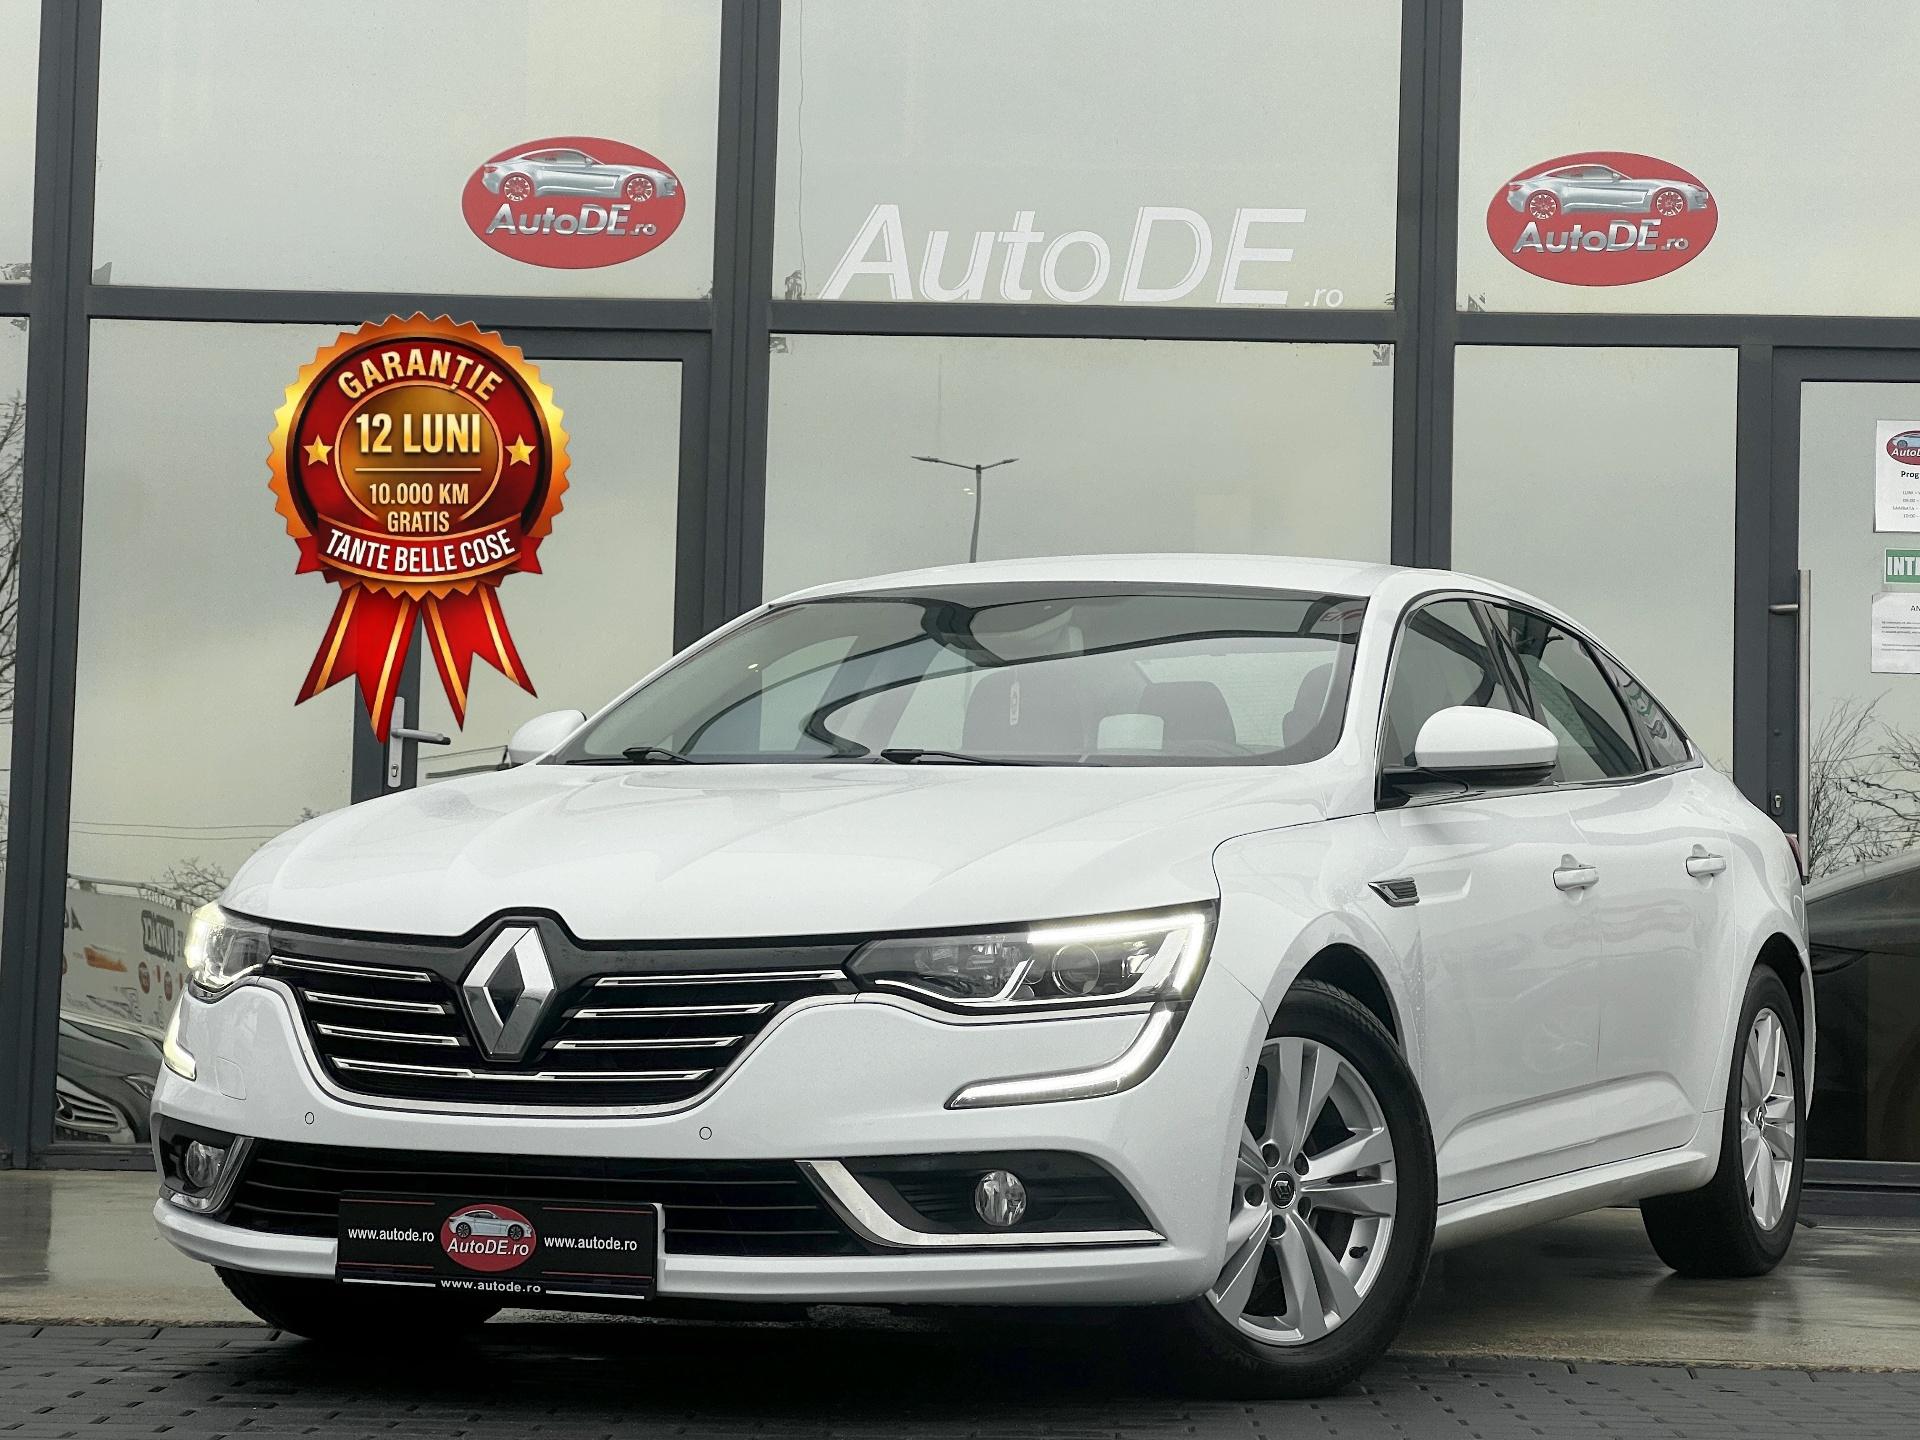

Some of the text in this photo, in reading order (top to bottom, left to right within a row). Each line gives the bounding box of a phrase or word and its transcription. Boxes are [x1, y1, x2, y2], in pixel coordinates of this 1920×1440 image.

[348, 1226, 435, 1243] www.autode.ro
[543, 1234, 638, 1252] www.autode.ro
[446, 1237, 530, 1257] AutoDE.ro
[440, 1278, 542, 1294] www.autode.ro
